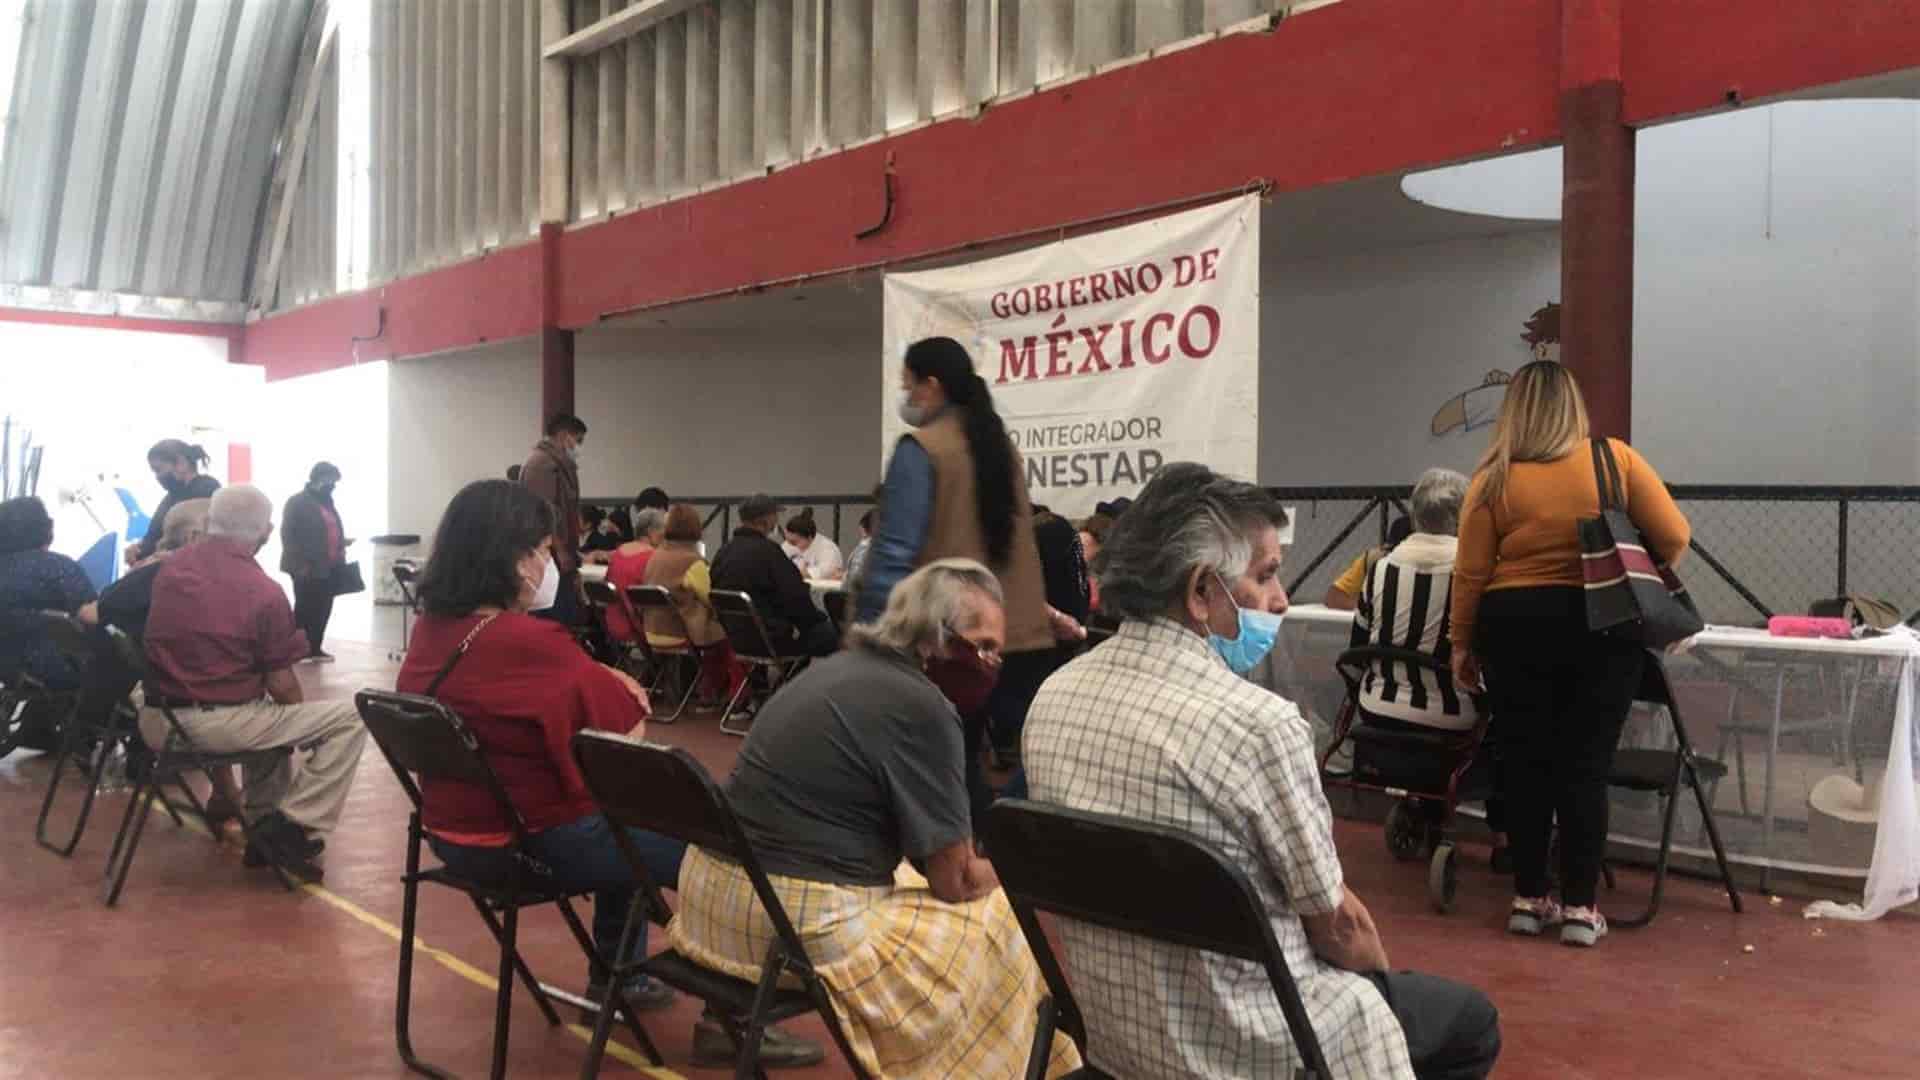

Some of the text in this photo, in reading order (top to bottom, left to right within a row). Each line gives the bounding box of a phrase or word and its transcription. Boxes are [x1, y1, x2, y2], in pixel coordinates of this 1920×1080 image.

[990, 249, 1219, 320] GOBIERNO DE
[996, 305, 1221, 384] MÉXICO
[1026, 416, 1162, 449] INTEGRADOR
[1026, 450, 1163, 489] NESTAR
